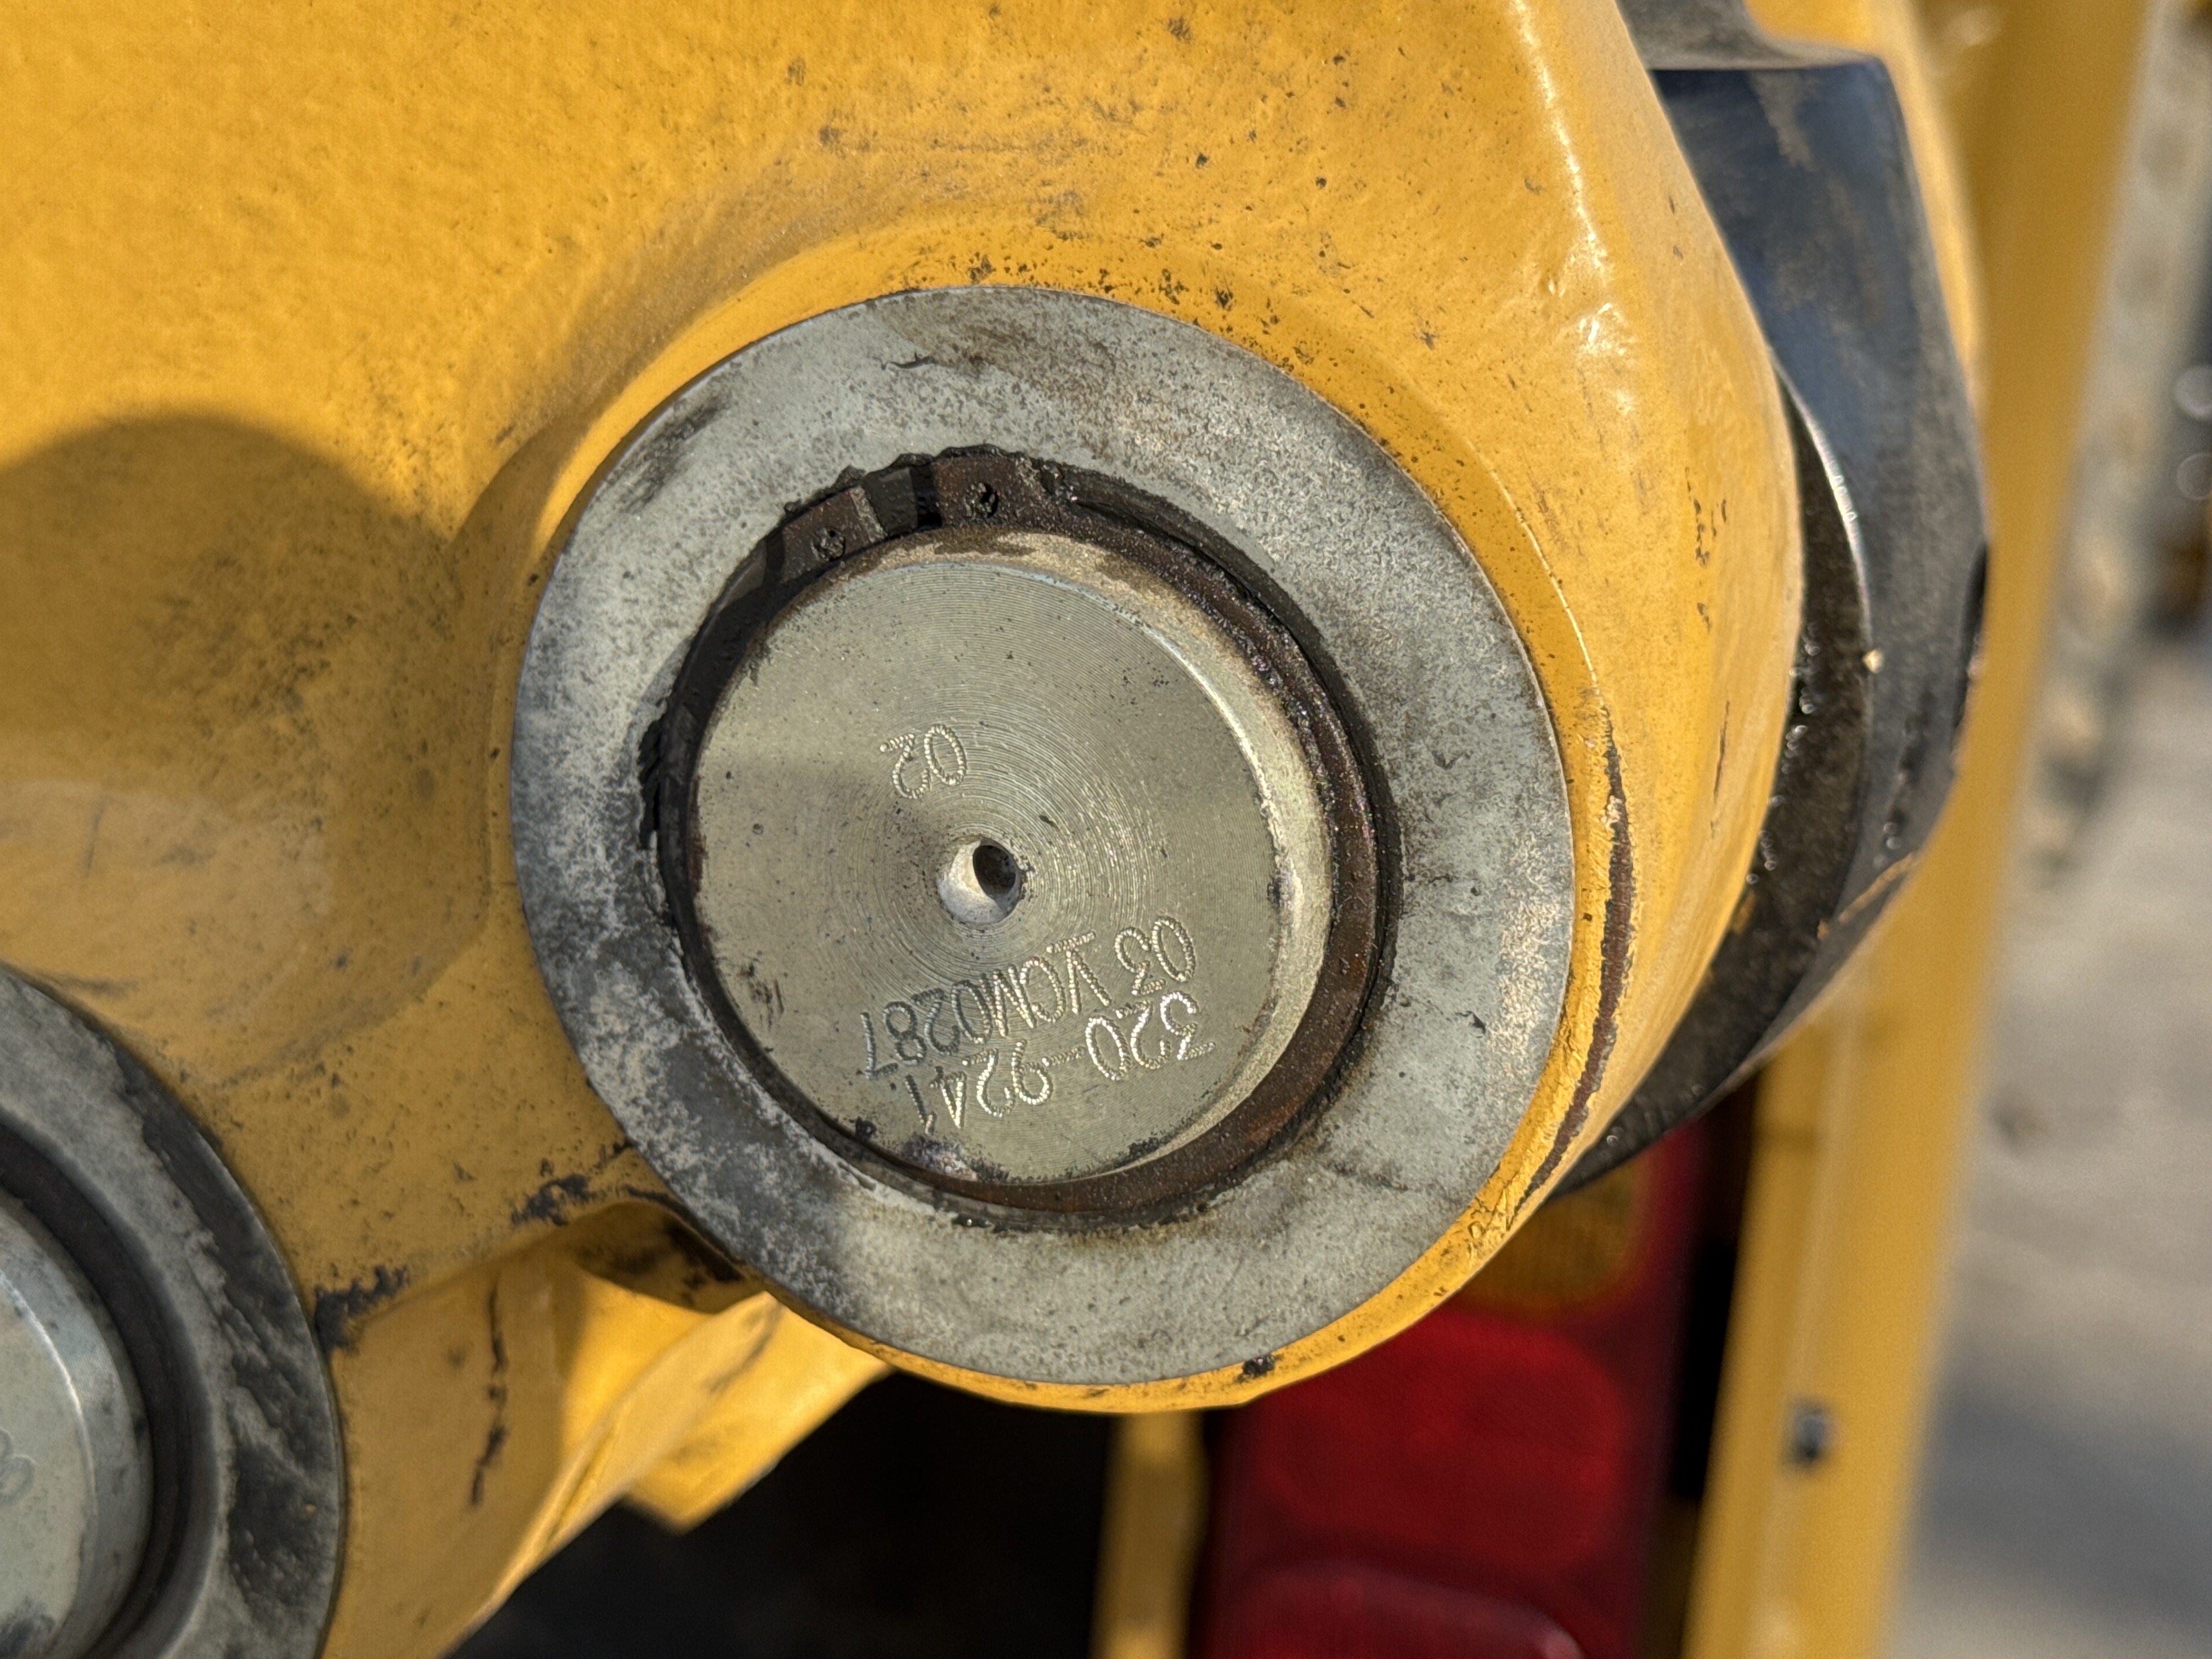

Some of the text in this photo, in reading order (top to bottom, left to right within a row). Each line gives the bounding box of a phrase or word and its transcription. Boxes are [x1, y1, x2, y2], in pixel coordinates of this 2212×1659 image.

[879, 724, 966, 799] 02
[1114, 915, 1197, 995] 03
[905, 990, 1217, 1135] 320-9241
